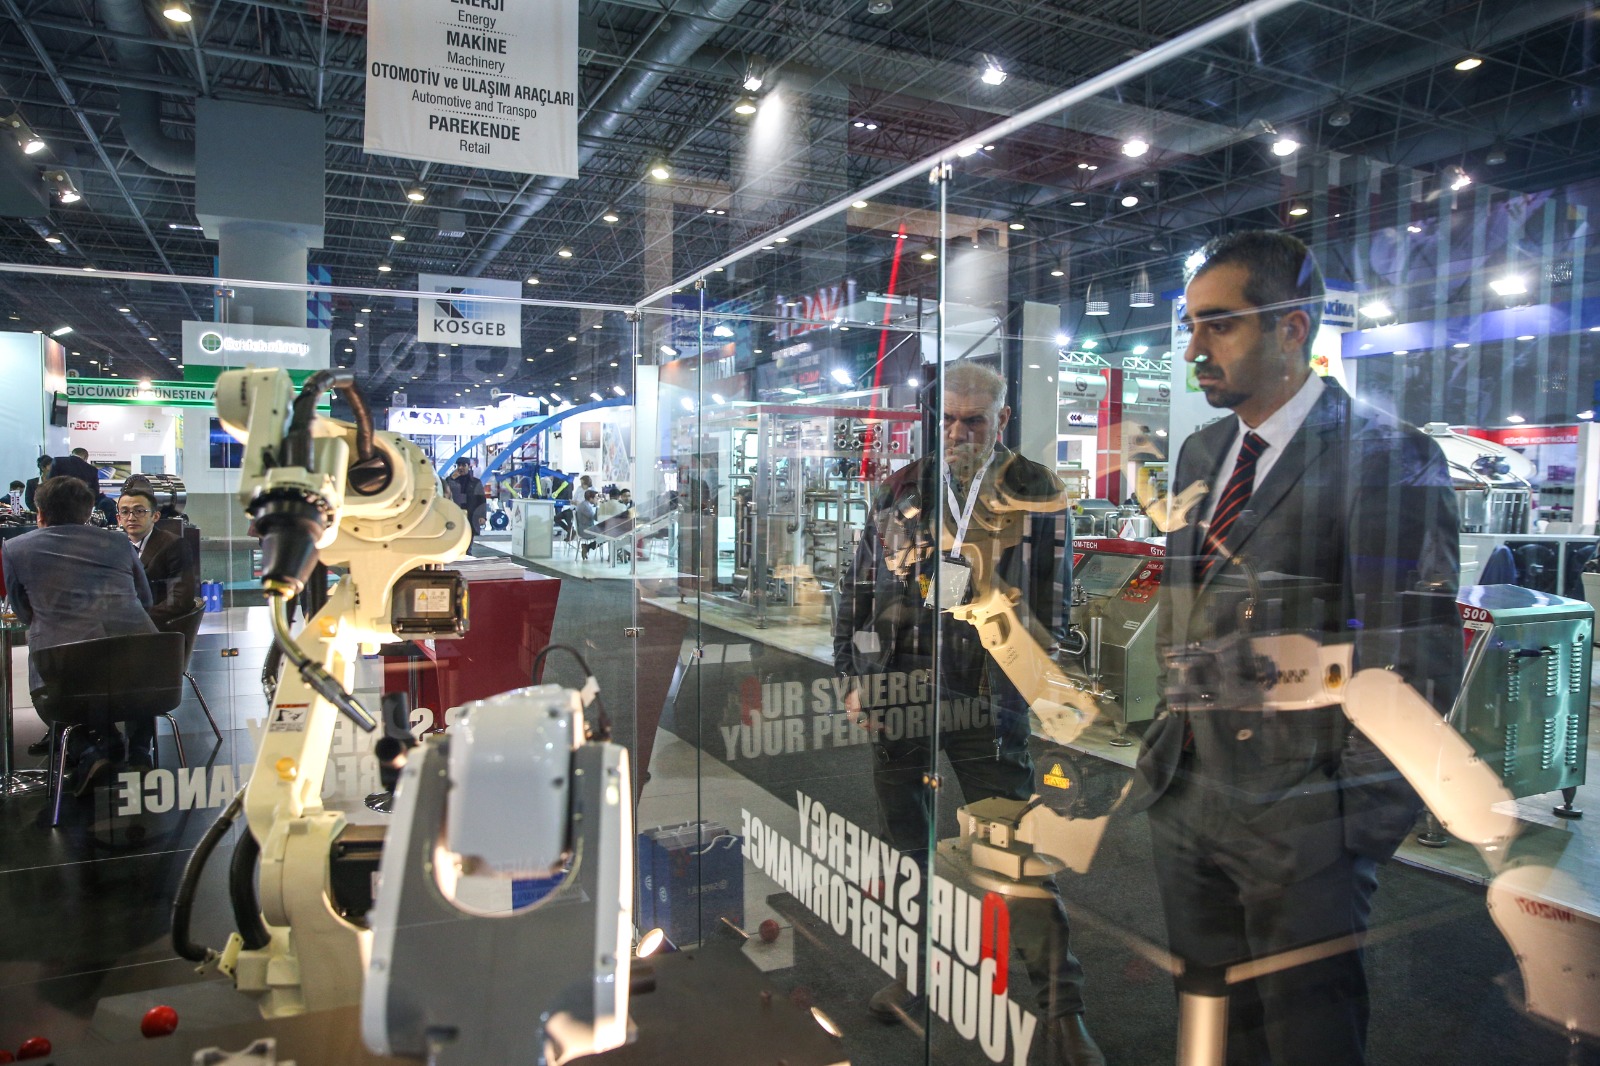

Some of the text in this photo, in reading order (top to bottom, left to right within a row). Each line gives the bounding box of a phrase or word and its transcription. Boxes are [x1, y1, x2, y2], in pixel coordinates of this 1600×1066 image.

[458, 9, 497, 29] Energy
[446, 30, 507, 54] MAKİNE
[447, 50, 506, 73] Machinery
[371, 62, 574, 106] OTOMOTİV ve ULAŞIM ARAÇLARI
[412, 89, 537, 119] Automotive and Transpo
[429, 115, 521, 141] PAREKENDE
[459, 140, 490, 154] Retail
[433, 319, 506, 336] KOSGEB
[1463, 608, 1487, 620] 500
[720, 709, 804, 761] YOUR
